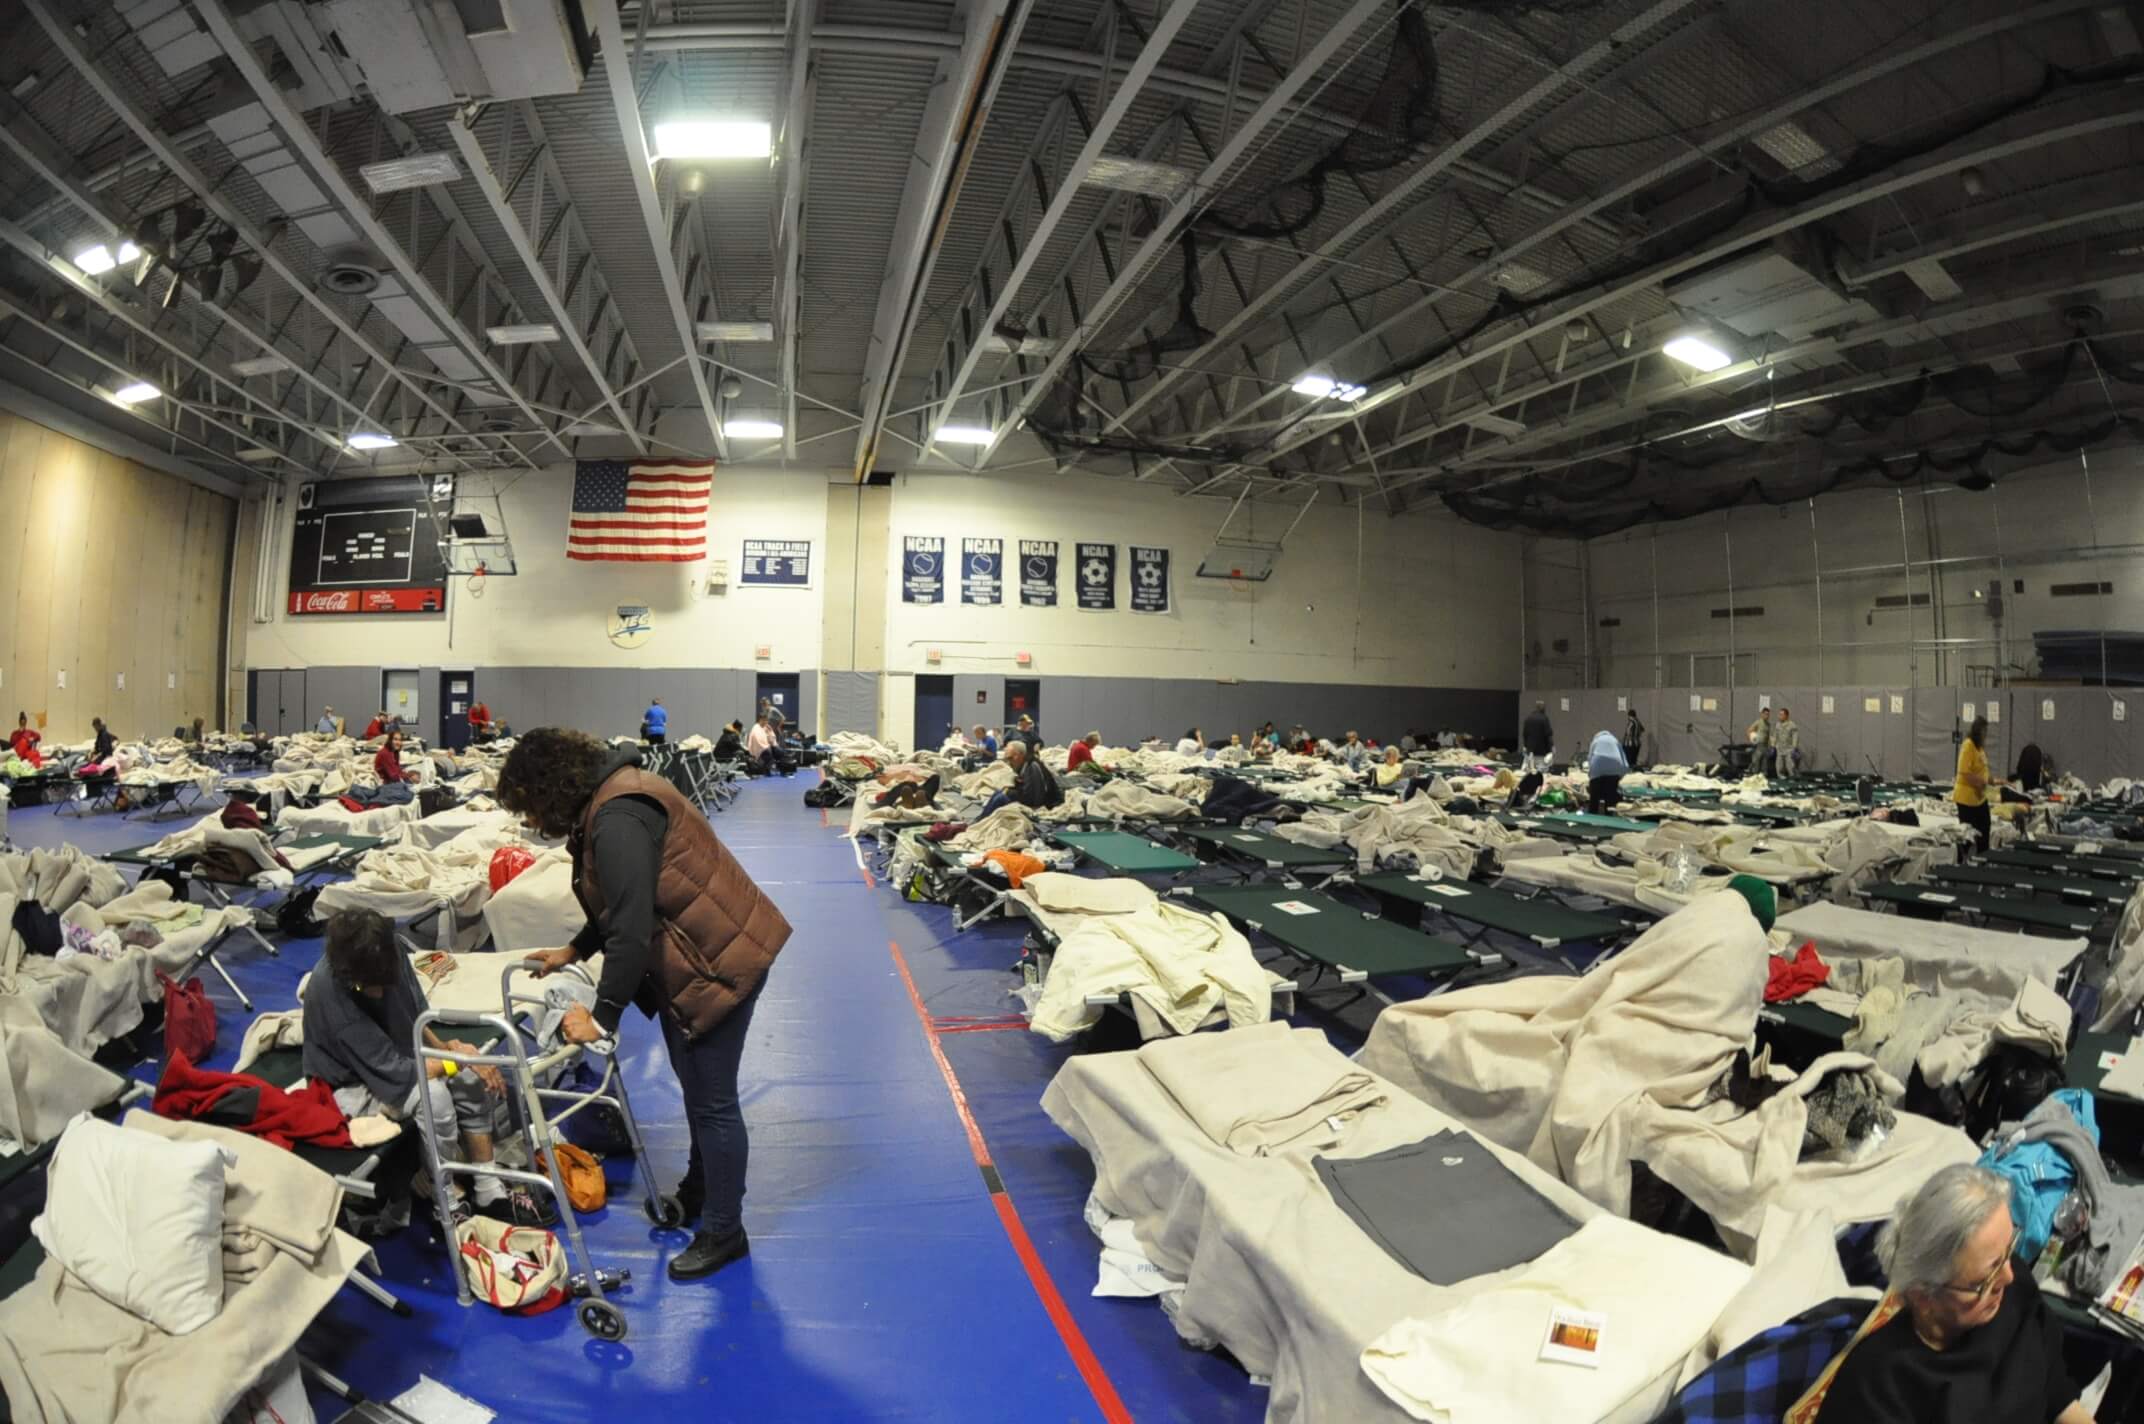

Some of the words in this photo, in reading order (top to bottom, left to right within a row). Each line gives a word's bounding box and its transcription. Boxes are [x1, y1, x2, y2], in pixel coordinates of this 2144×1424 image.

[906, 537, 942, 552] NCAA
[964, 538, 1001, 554] NCAA
[1021, 541, 1057, 557] NCAA
[1082, 545, 1109, 558] NCAA
[1137, 549, 1162, 562] NCAA
[616, 613, 649, 630] NEC
